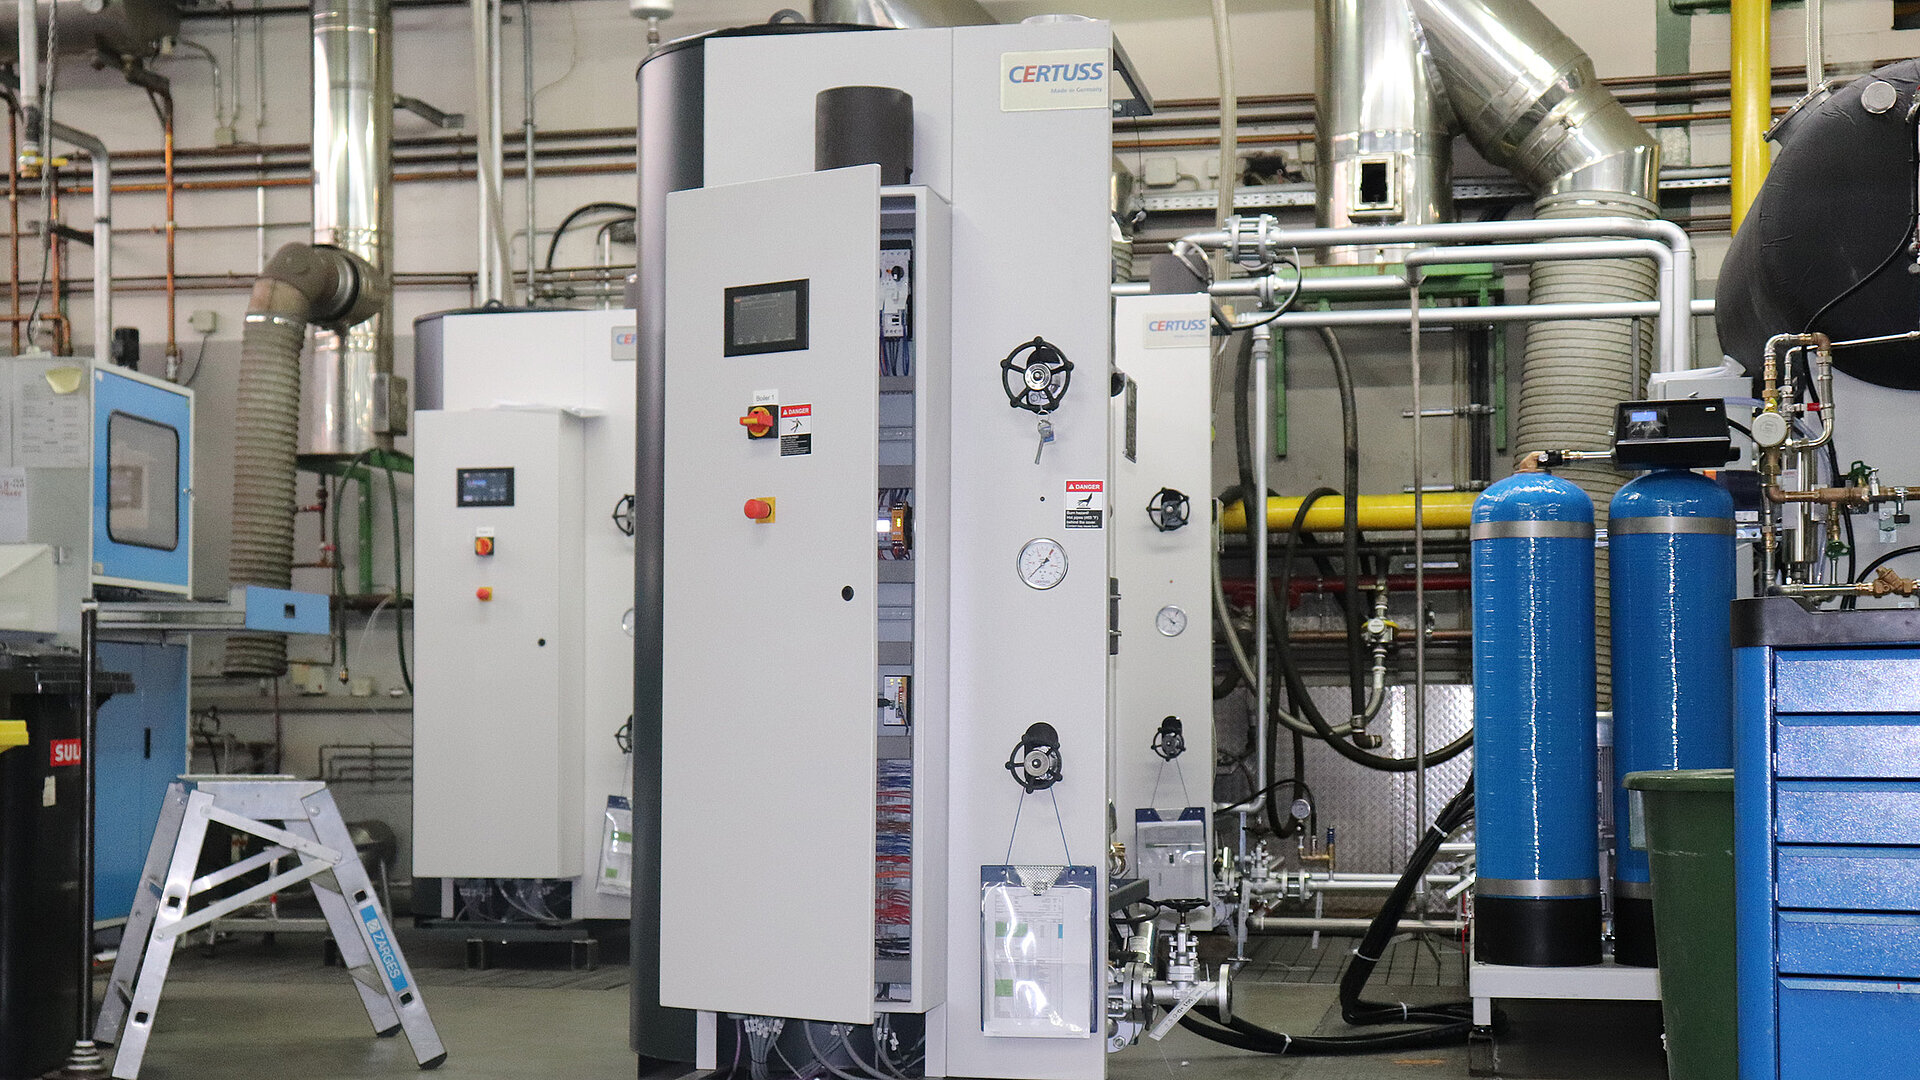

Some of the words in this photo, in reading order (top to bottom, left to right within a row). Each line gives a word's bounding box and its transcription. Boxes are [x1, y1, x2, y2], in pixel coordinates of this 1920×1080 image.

[1008, 62, 1104, 83] CERTUSS
[1076, 86, 1102, 94] Germany
[1148, 320, 1207, 332] CERTUSS
[756, 394, 770, 402] Boiler
[788, 407, 809, 415] DANGER
[55, 743, 81, 762] SUL
[373, 932, 400, 979] ZARGES
